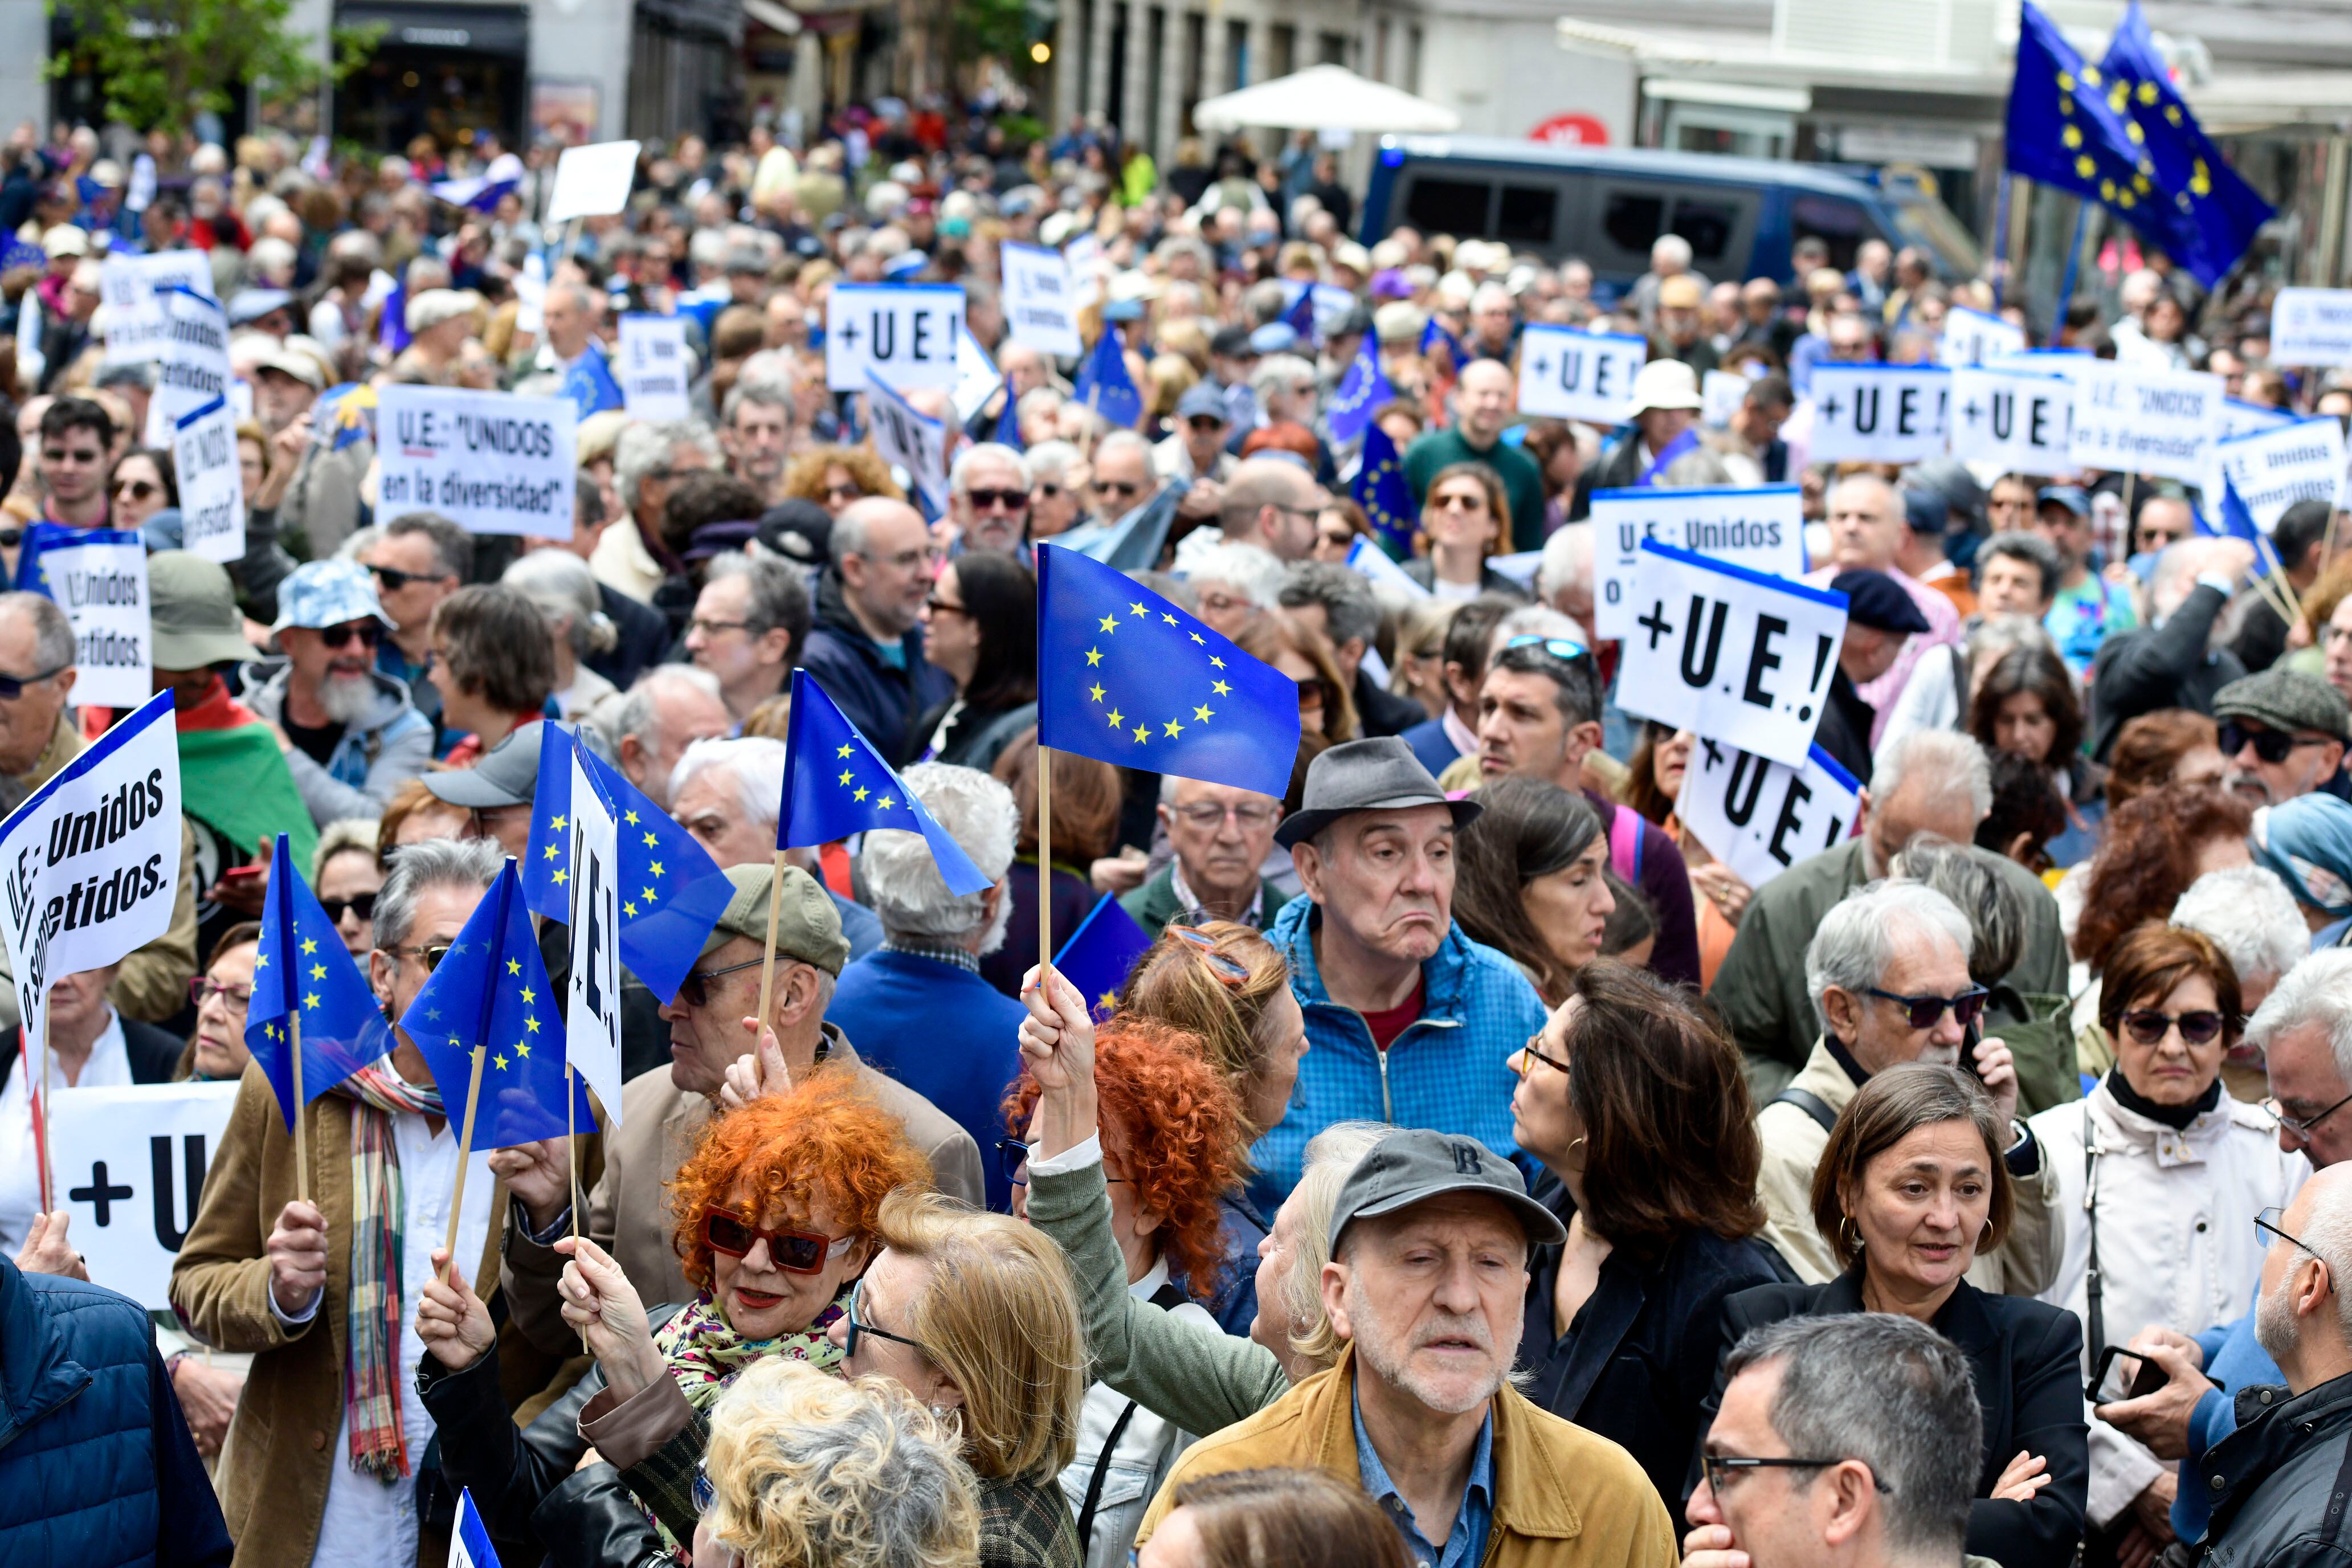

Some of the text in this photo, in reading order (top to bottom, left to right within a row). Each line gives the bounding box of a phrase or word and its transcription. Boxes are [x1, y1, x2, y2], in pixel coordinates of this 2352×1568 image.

[384, 473, 409, 503] en
[416, 466, 434, 505] la
[1686, 516, 1782, 550] Unidos
[47, 767, 163, 867] Unidos
